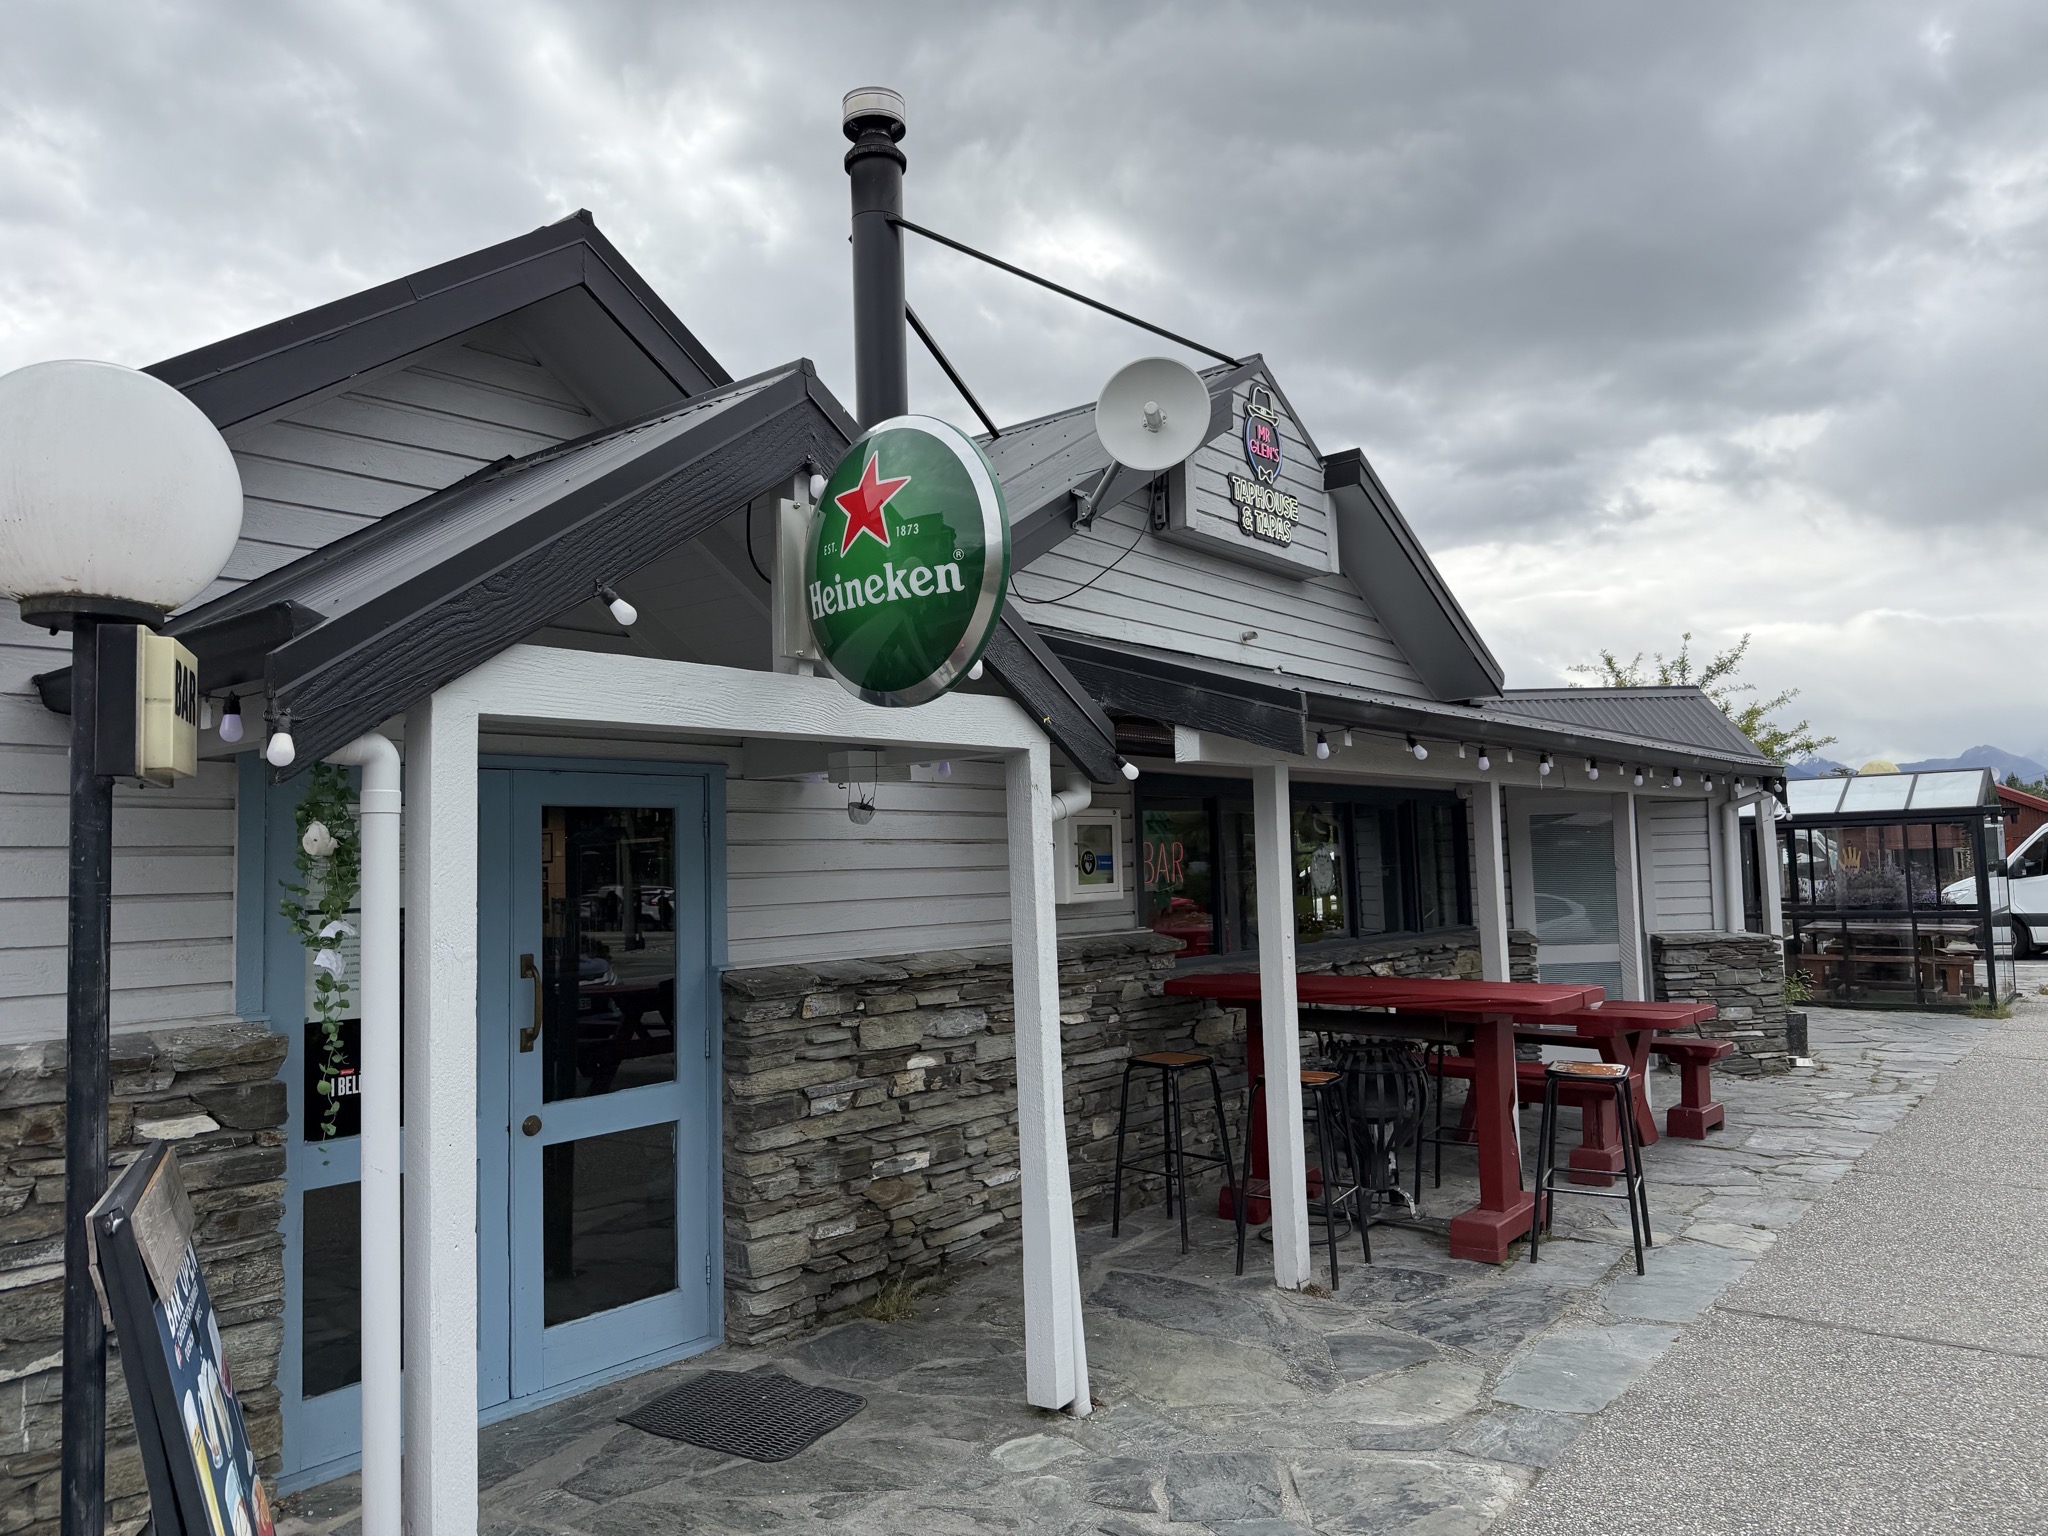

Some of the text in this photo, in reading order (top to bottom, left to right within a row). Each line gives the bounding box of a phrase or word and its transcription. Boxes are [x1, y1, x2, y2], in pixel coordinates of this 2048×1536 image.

[1249, 438, 1280, 463] GLEN'S
[1257, 424, 1271, 443] MR
[1232, 475, 1299, 522] TAPHOUSE
[823, 523, 920, 556] EST. 1873
[1242, 506, 1292, 543] & TAPAS
[809, 561, 966, 621] Heineken
[175, 659, 197, 727] BAR
[1143, 841, 1184, 884] BAR
